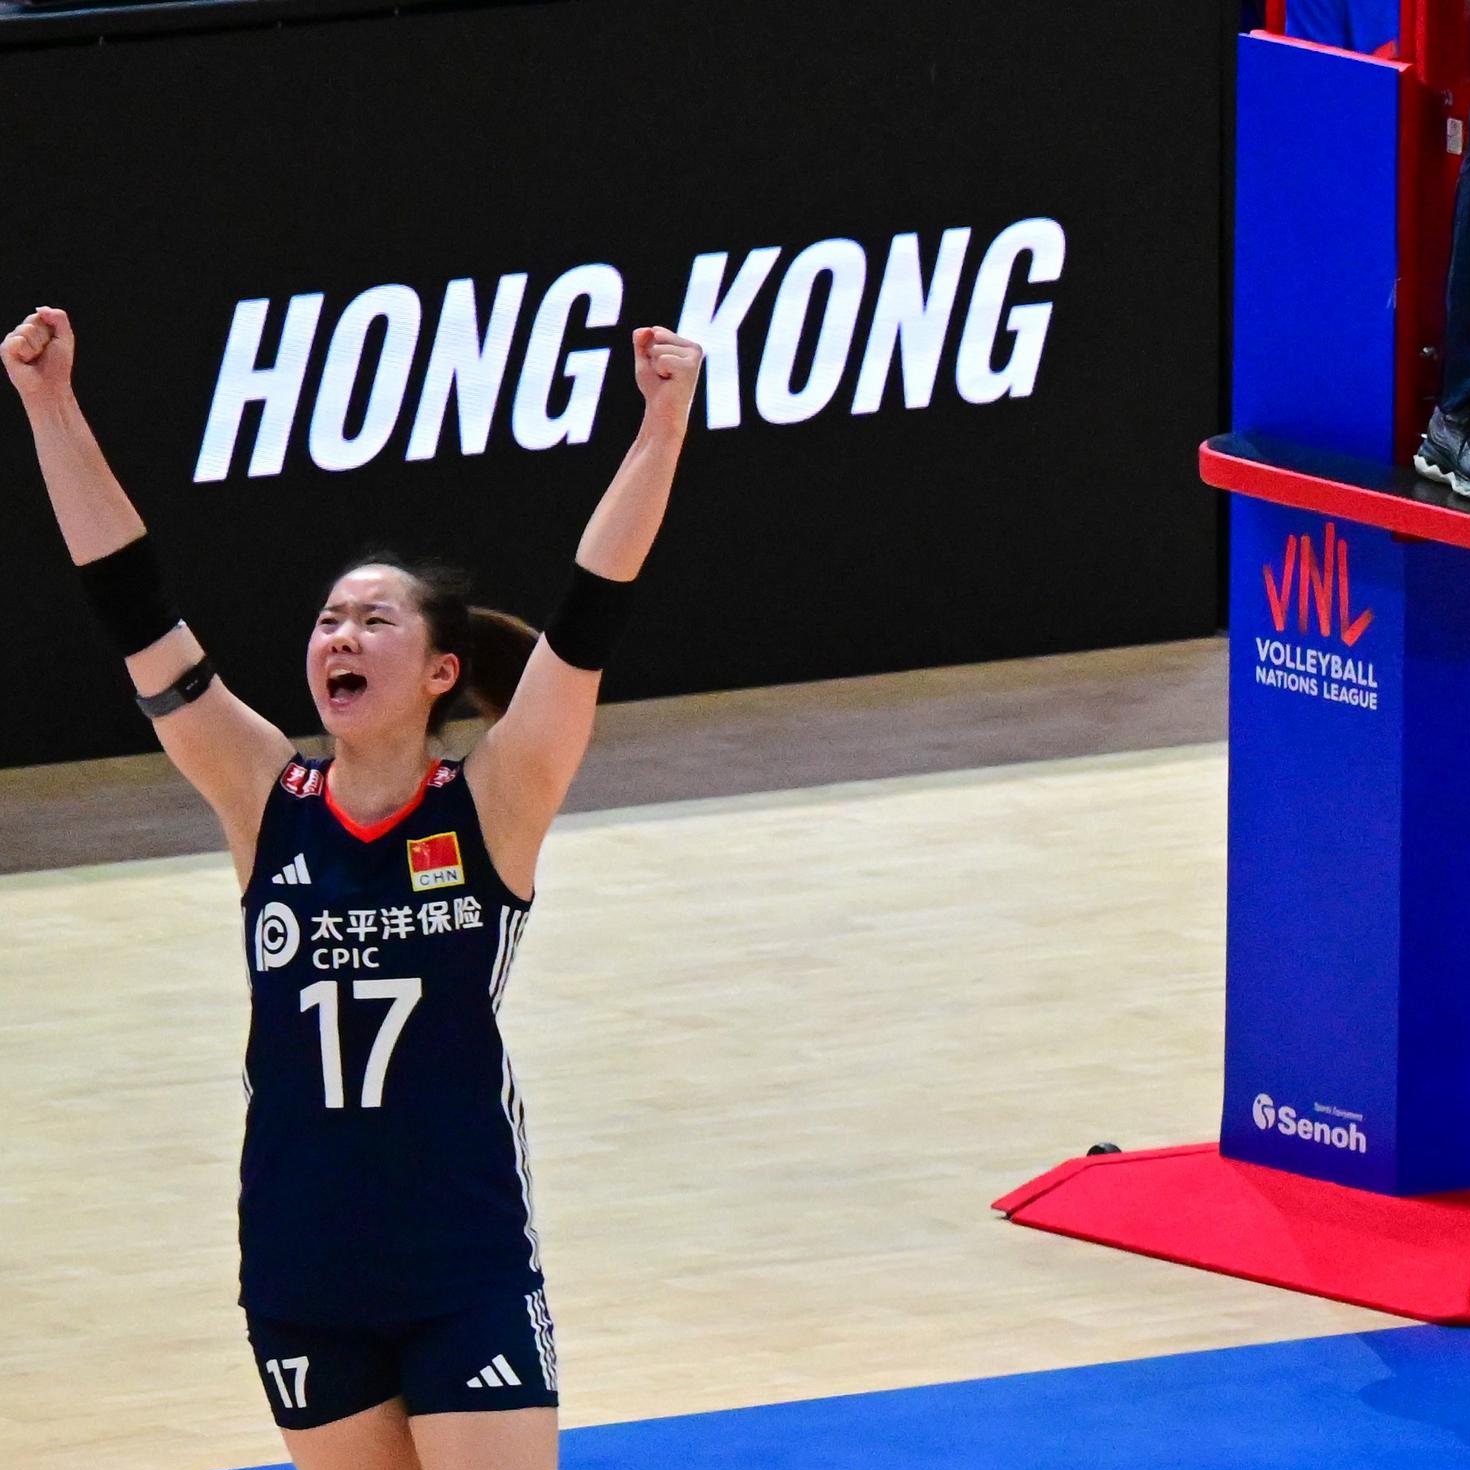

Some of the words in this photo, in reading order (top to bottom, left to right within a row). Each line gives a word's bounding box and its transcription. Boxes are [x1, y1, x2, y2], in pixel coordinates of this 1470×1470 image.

[192, 262, 625, 483] HONG
[674, 217, 1067, 430] KONG
[1263, 522, 1374, 647] VNL
[1256, 637, 1378, 688] VOLLEYBALL
[1256, 665, 1318, 696] NATIONS
[1323, 681, 1378, 711] LEAGUE
[419, 869, 458, 886] CHN
[311, 896, 484, 942] 太平洋保险
[312, 947, 380, 970] CPIC
[300, 977, 422, 1109] 17
[1277, 1105, 1366, 1153] Senoh
[266, 1356, 309, 1409] 17
